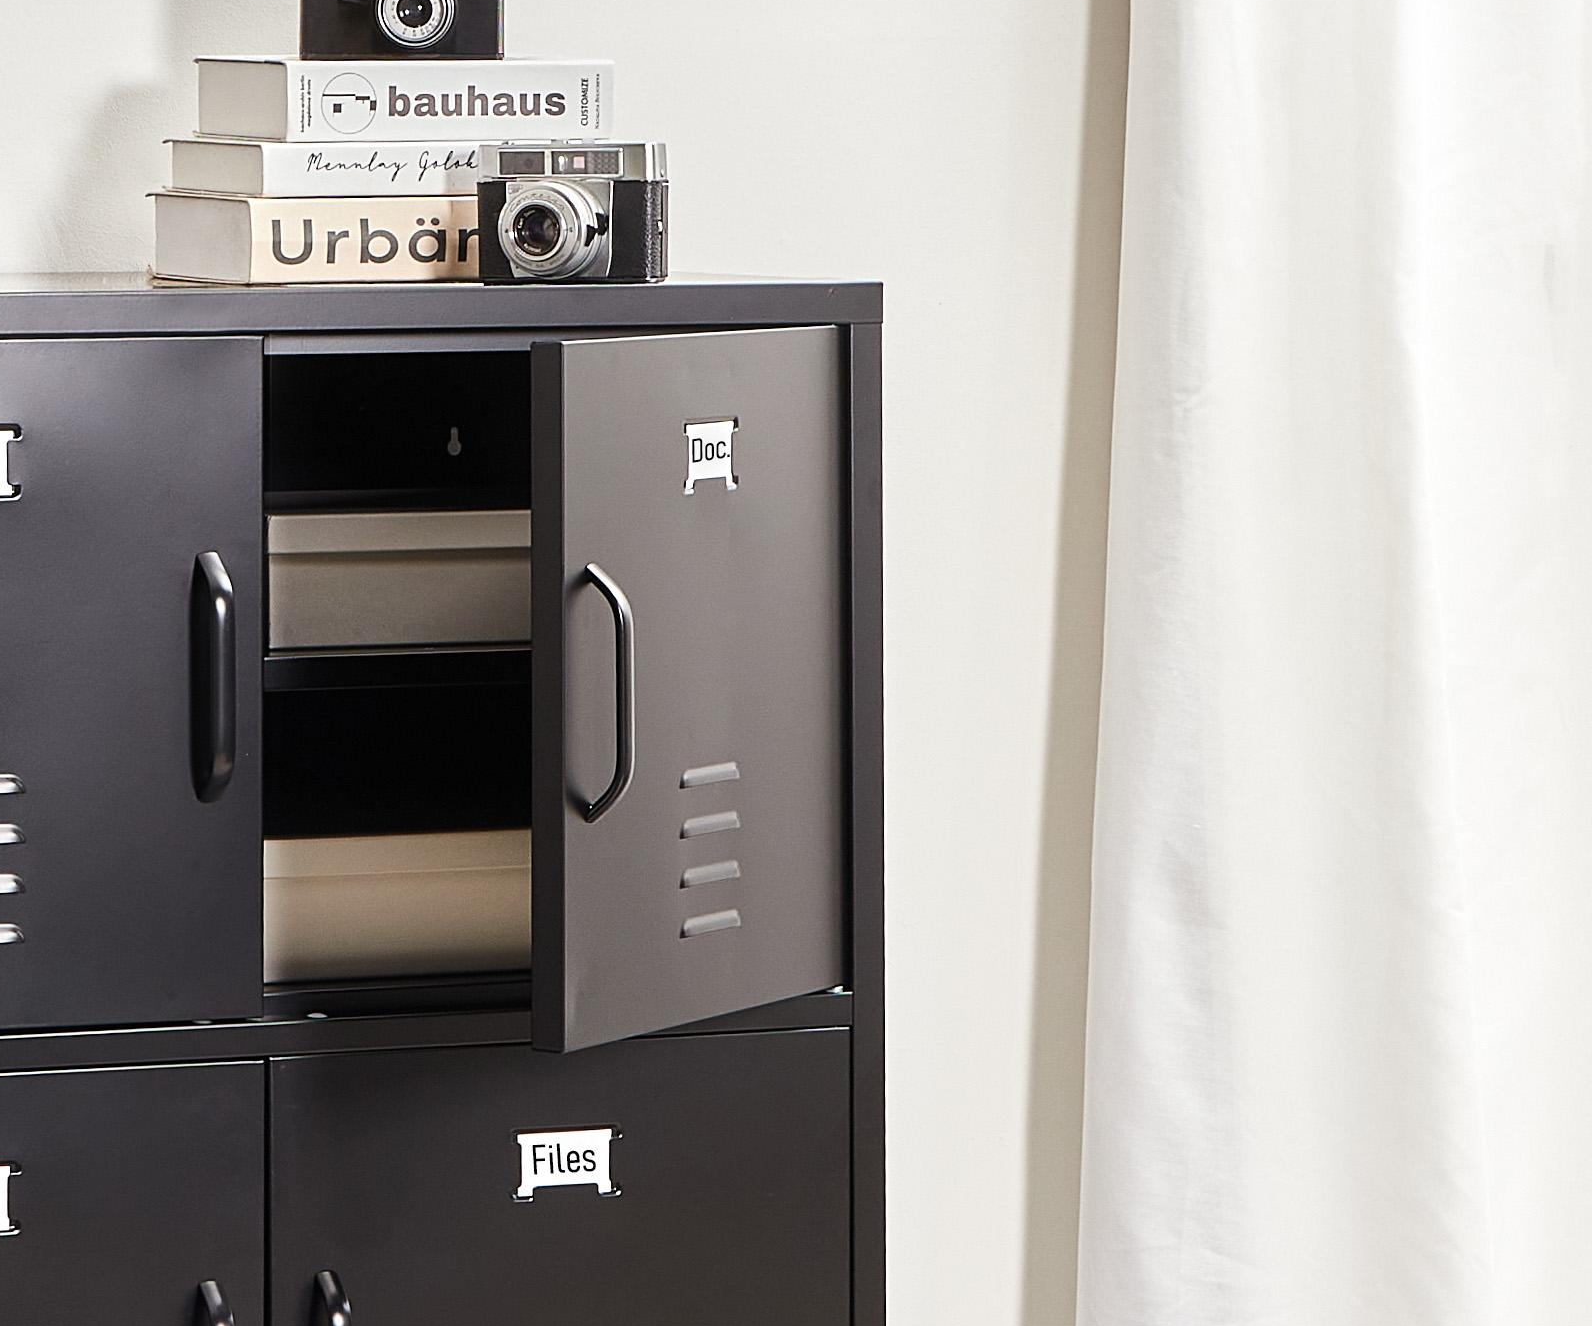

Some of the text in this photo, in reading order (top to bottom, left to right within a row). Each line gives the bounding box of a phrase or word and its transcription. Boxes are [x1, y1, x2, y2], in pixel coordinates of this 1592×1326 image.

[388, 85, 566, 117] bauhaus
[580, 77, 589, 127] CUSTOMIZE
[691, 437, 731, 464] Doc.
[532, 1143, 597, 1175] Files
